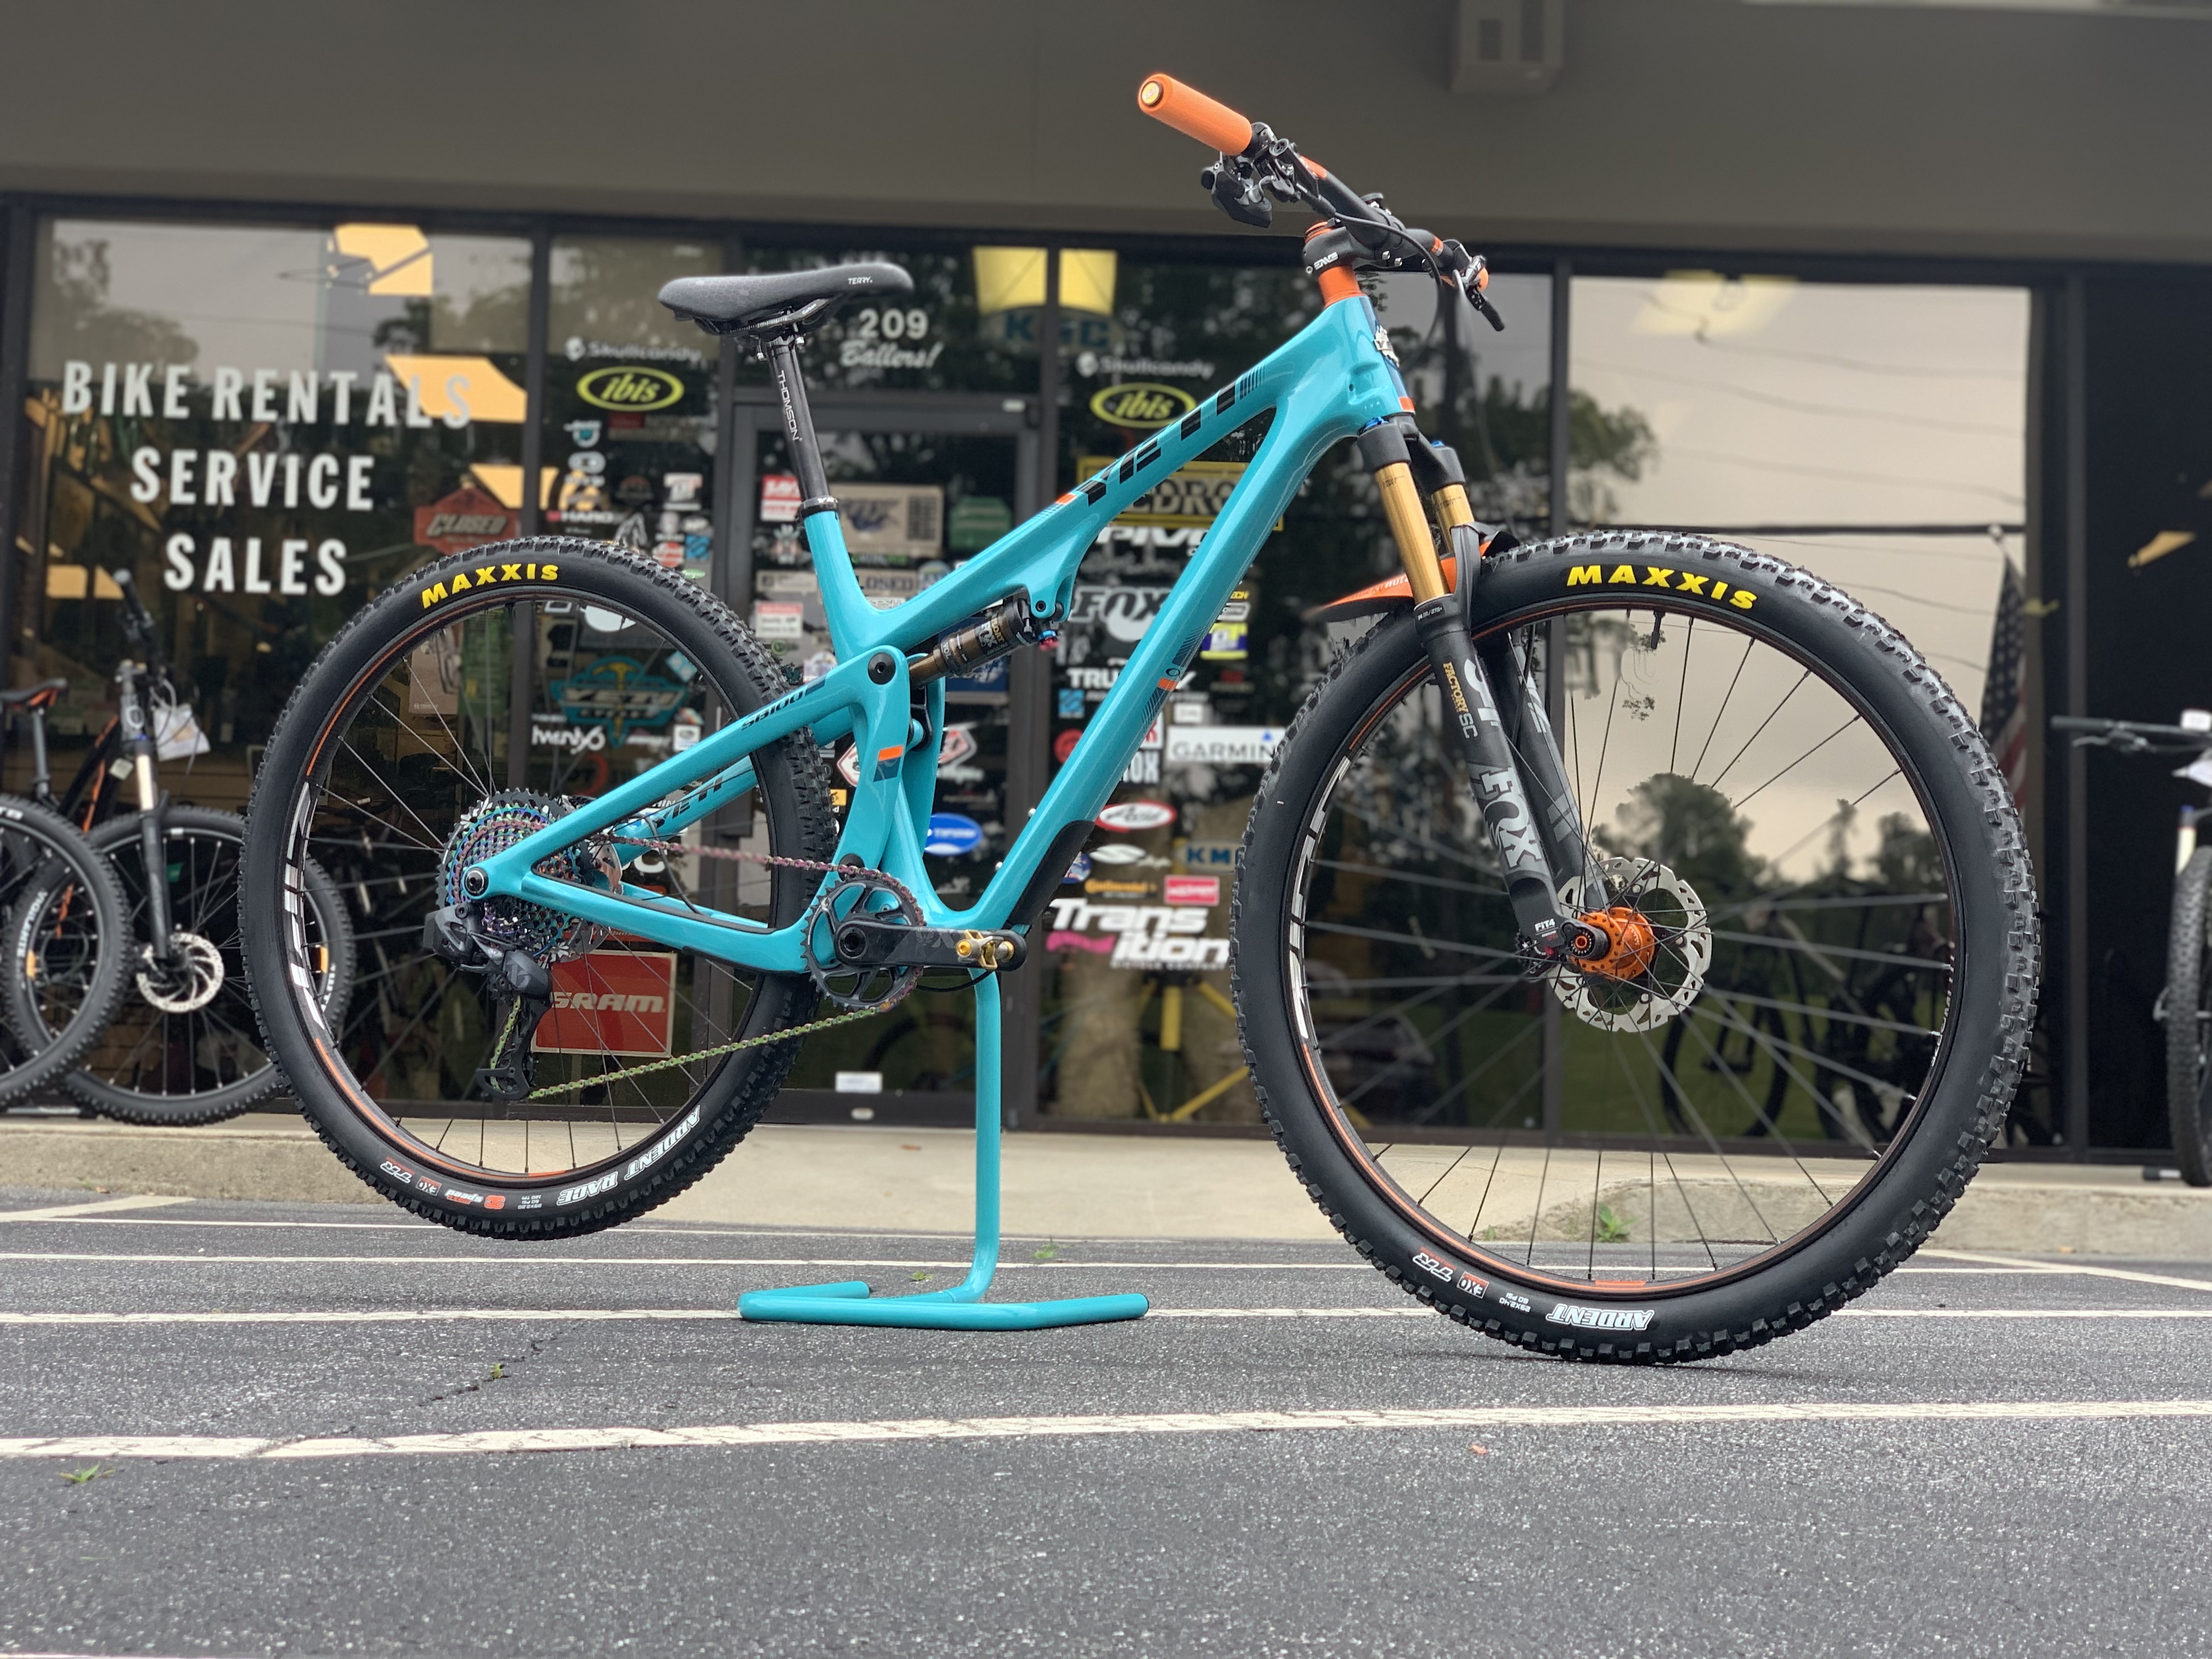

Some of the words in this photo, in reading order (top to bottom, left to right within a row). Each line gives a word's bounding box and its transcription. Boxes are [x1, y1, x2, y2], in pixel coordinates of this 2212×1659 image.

[857, 308, 929, 340] 209
[63, 360, 190, 419] BIKE
[211, 365, 472, 430] RENTALS
[600, 373, 661, 402] ibis
[1114, 389, 1175, 419] ibis
[777, 370, 800, 442] THOMSON
[130, 445, 375, 512] SERVICE
[163, 532, 348, 596] SALES
[421, 563, 559, 609] MAXXIS
[1566, 565, 1758, 609] MAXXIS
[1068, 585, 1176, 651] FOX
[1443, 662, 1469, 713] FACTORY
[1459, 713, 1478, 738] SC
[1172, 741, 1277, 759] GARMIN
[1187, 844, 1239, 864] KM
[551, 991, 664, 1013] SRAM
[624, 1104, 701, 1181] ARDENT
[380, 1160, 412, 1184] TR
[556, 1171, 619, 1206] RACE
[1412, 1252, 1453, 1283] TR
[1457, 1277, 1485, 1297] EXO
[1545, 1303, 1655, 1331] ARDENT
